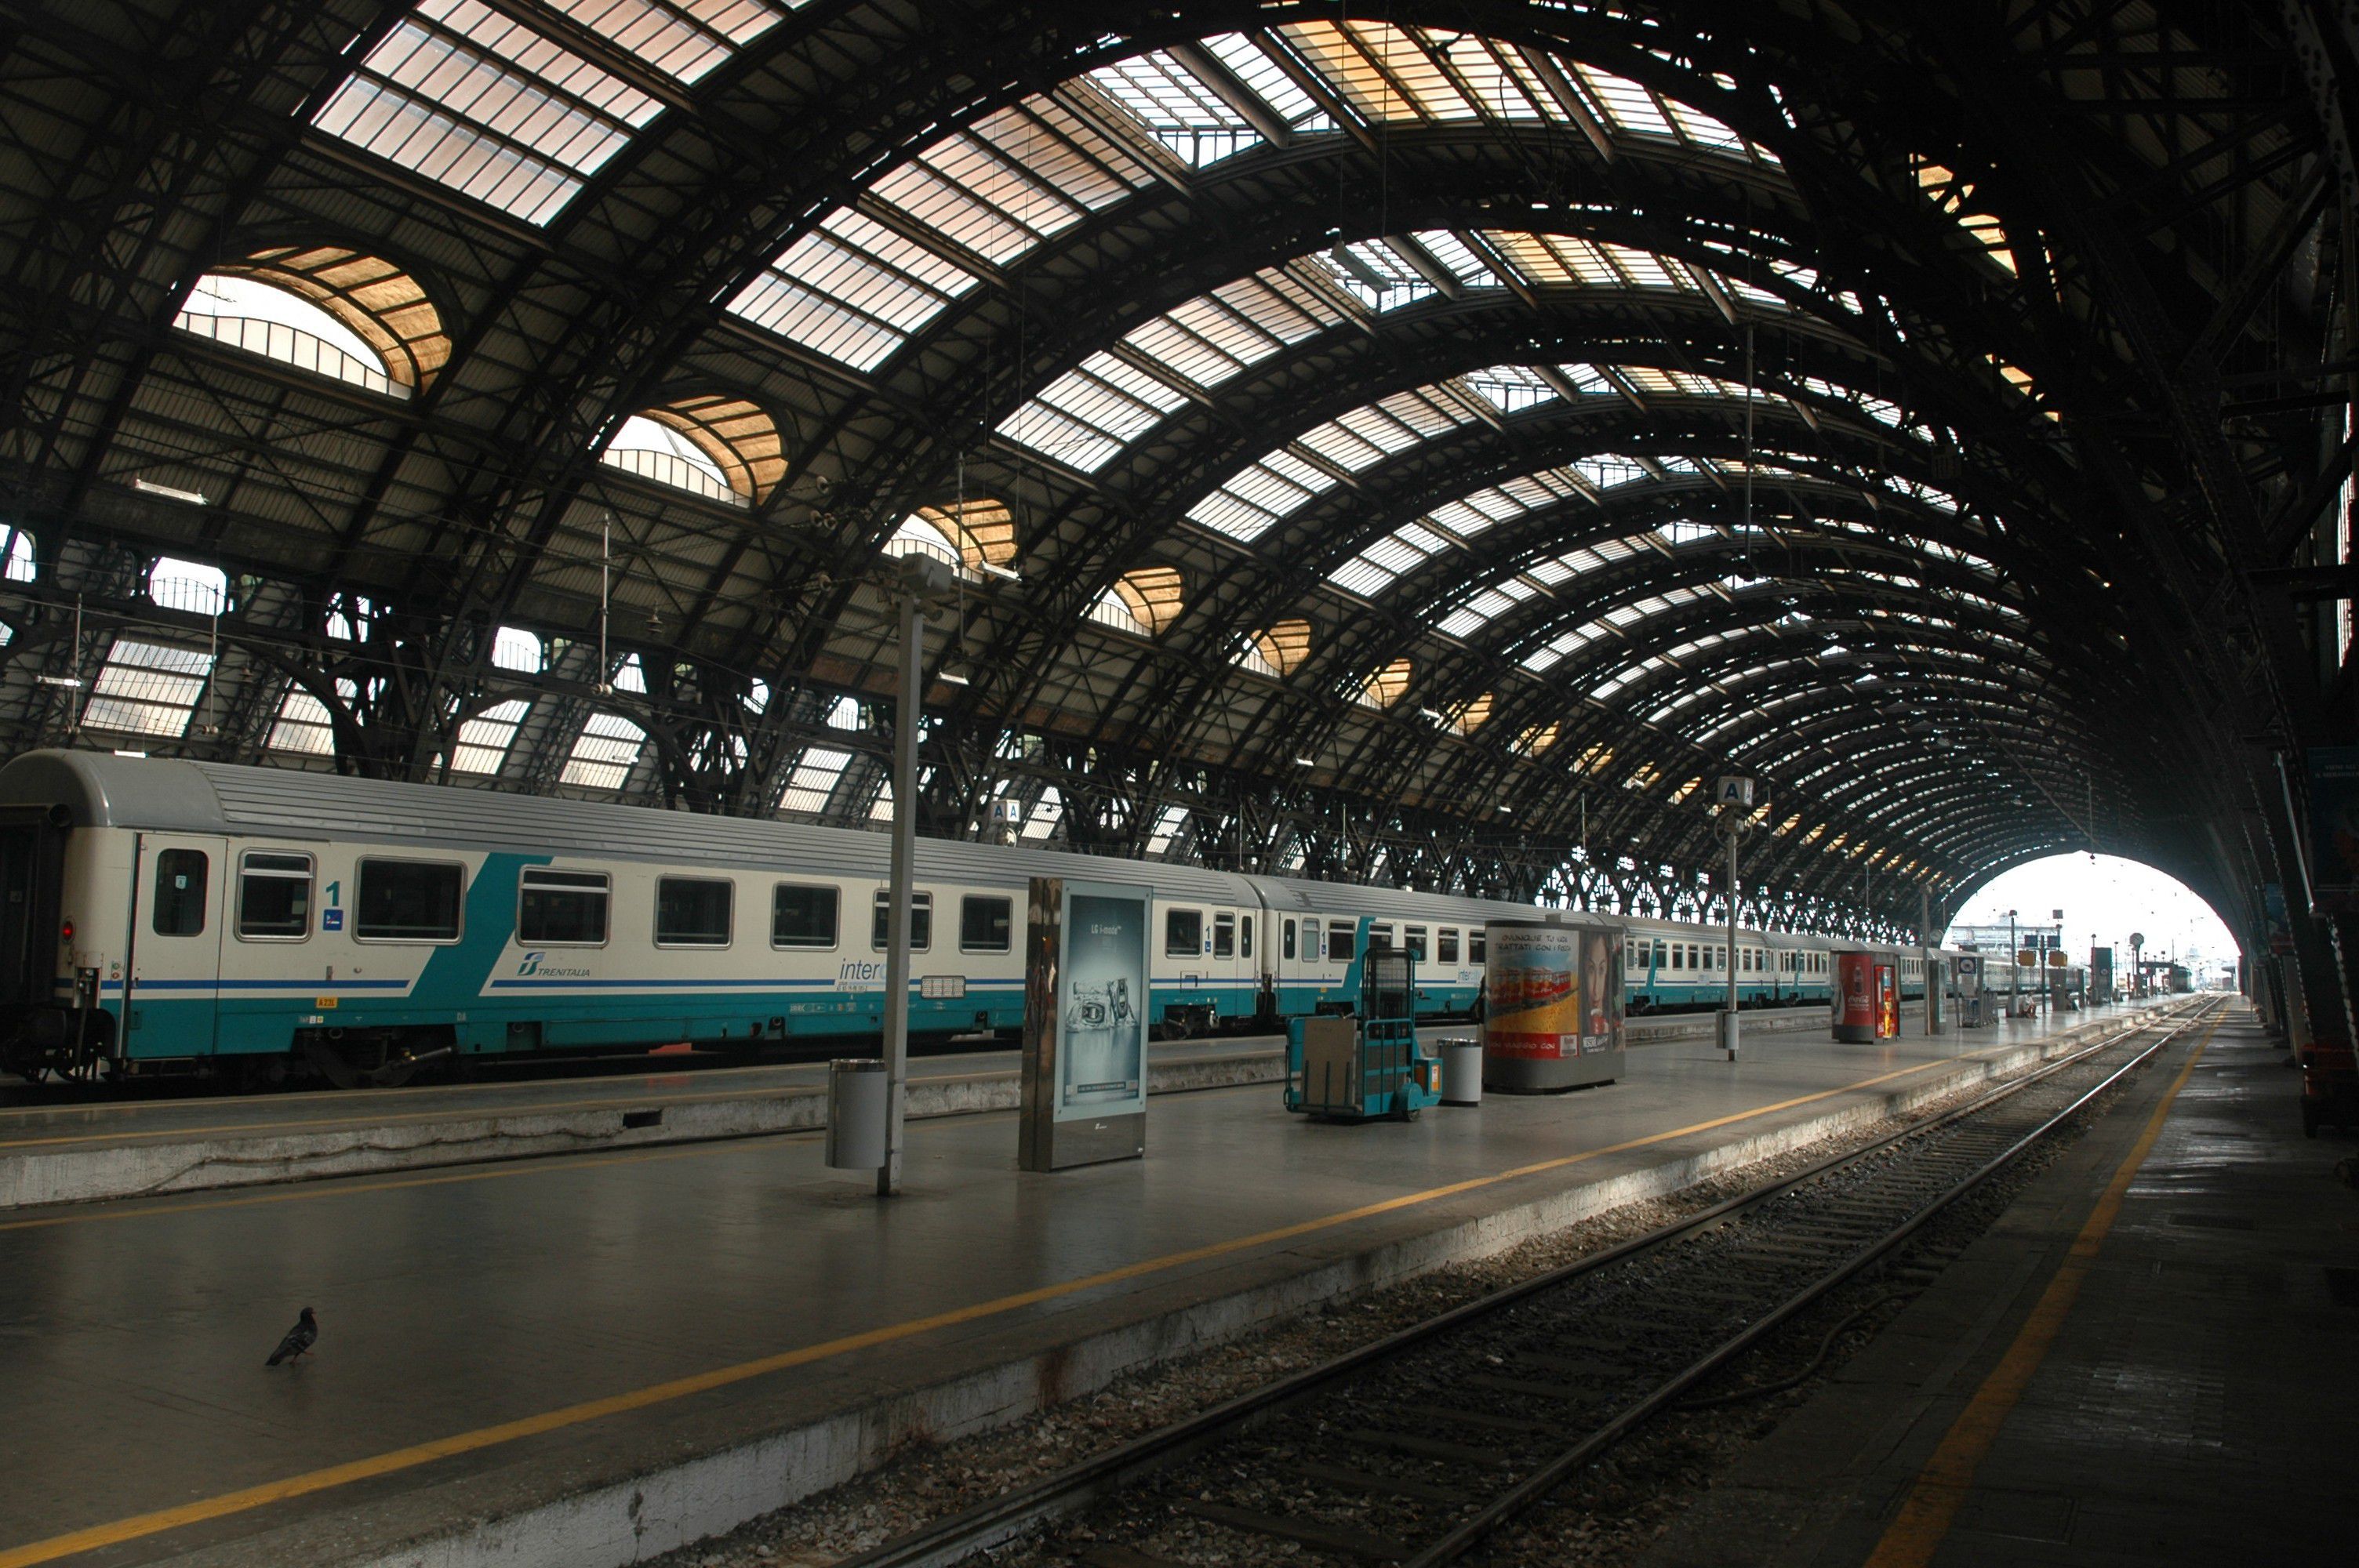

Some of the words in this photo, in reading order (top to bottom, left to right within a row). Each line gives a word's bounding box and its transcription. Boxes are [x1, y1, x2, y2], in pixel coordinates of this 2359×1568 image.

[1725, 783, 1739, 799] A
[994, 804, 1004, 817] A
[1010, 804, 1017, 818] A
[326, 880, 340, 906] 1
[1205, 925, 1210, 939] 1
[1321, 931, 1325, 943] 1
